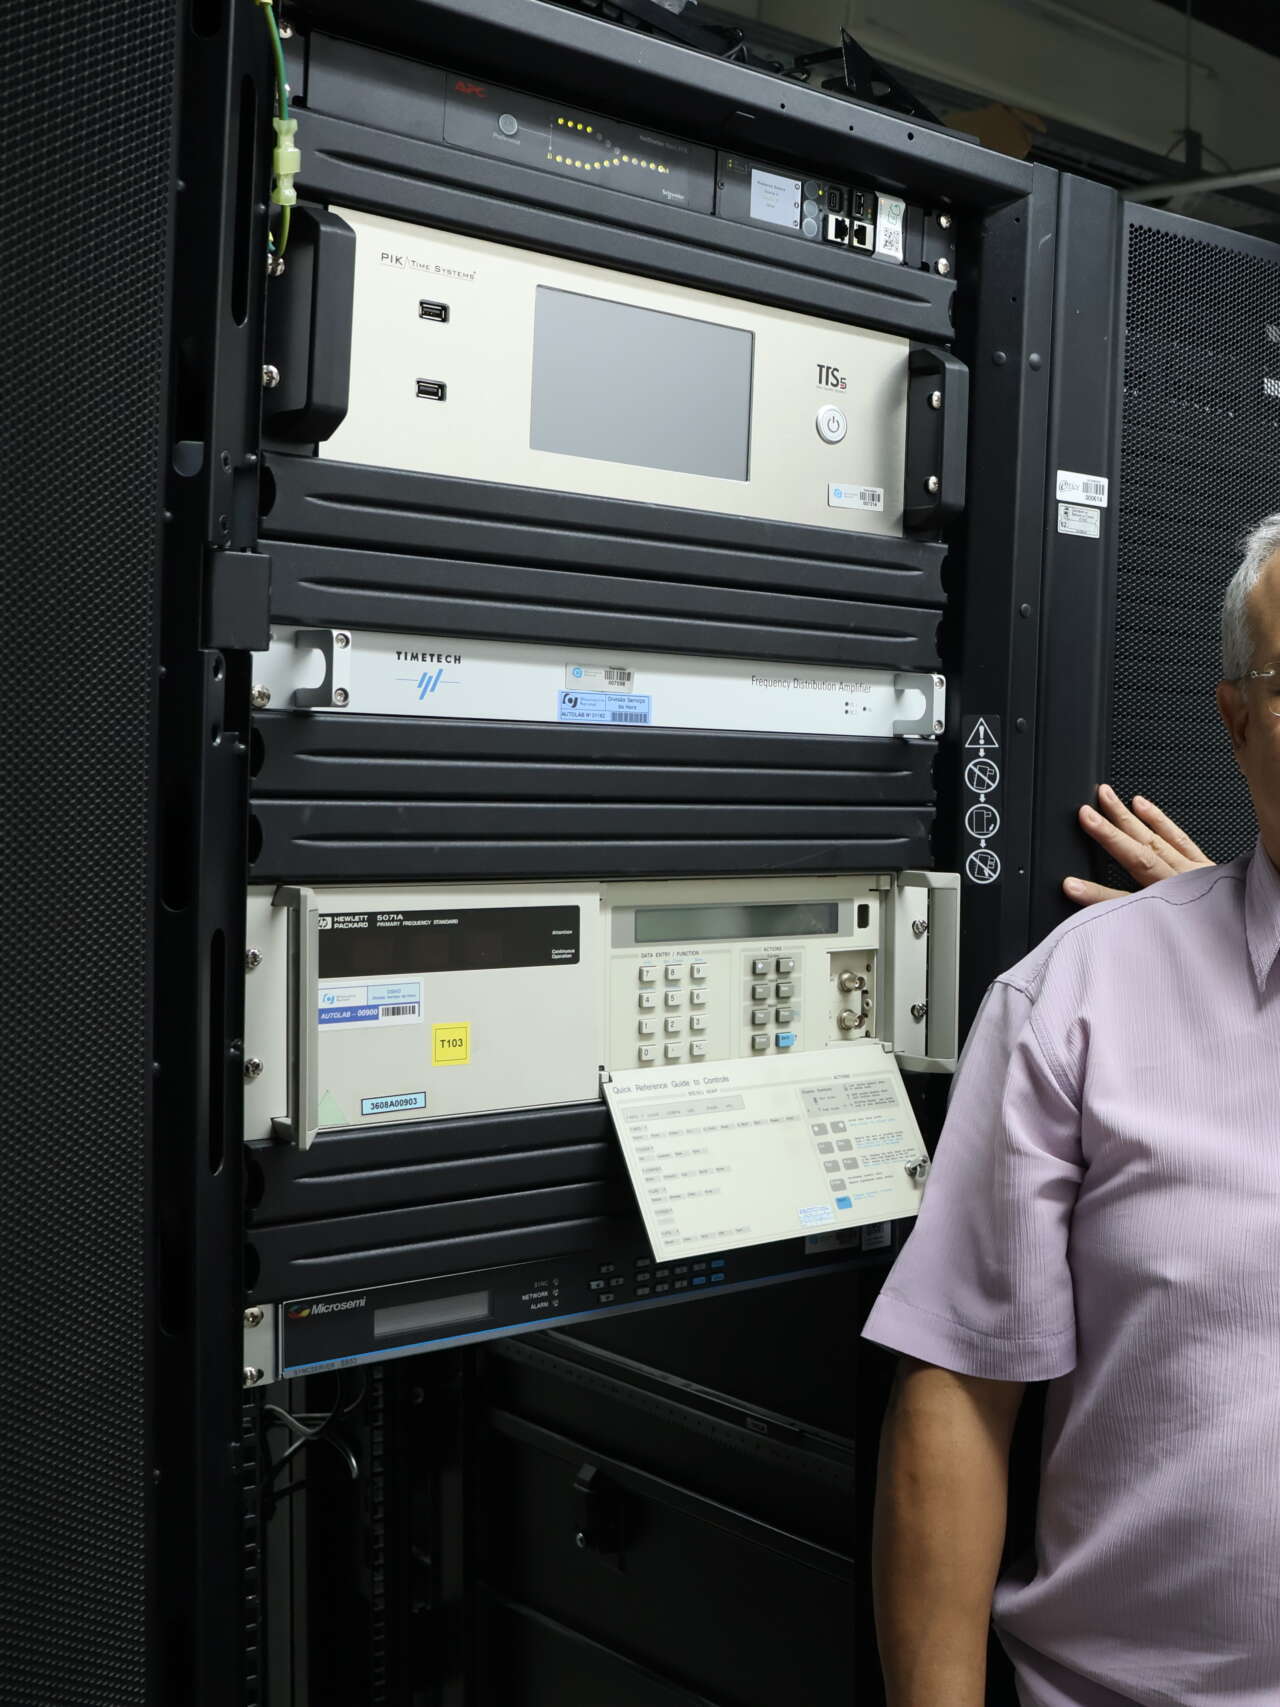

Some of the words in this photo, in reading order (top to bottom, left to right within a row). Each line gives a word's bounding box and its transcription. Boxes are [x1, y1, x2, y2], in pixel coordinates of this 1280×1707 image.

[380, 251, 403, 266] PIK
[395, 651, 462, 665] TIMETECH
[751, 675, 791, 689] Frequency
[793, 678, 837, 691] Distribution
[838, 681, 872, 694] Amplifier
[320, 1011, 351, 1019] AUTOLAB
[357, 1008, 378, 1017] 00900
[440, 1039, 464, 1048] T103
[634, 1082, 668, 1091] Reference
[671, 1080, 690, 1088] Guide
[703, 1075, 730, 1085] Controls
[370, 1097, 418, 1110] 3608A00903
[311, 1295, 367, 1315] Microsemi
